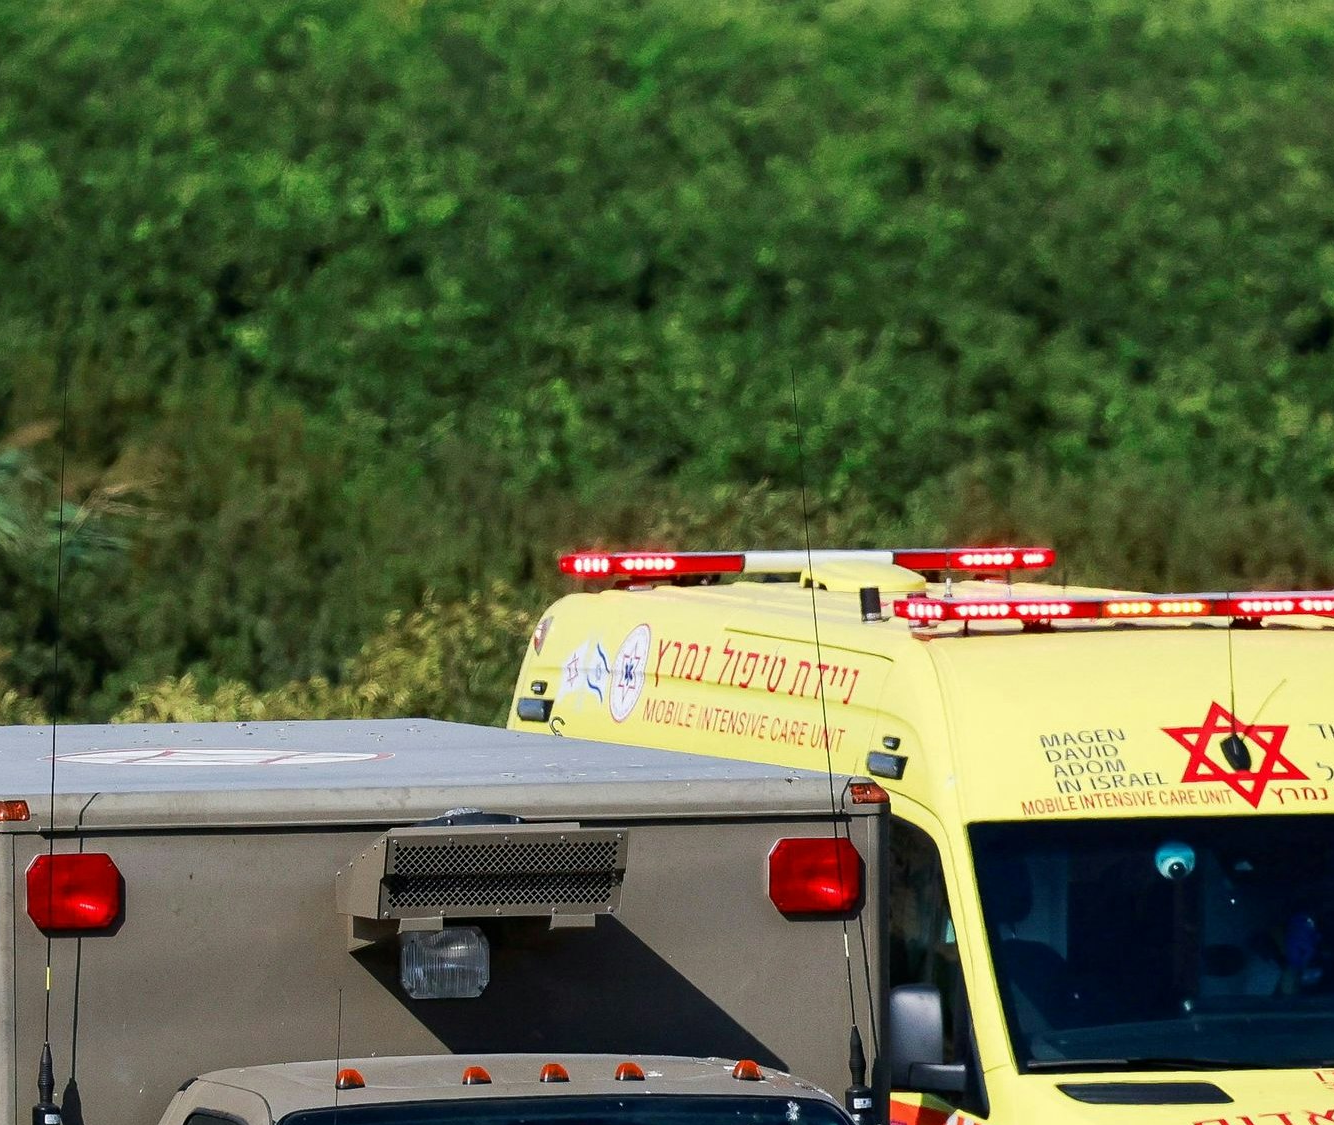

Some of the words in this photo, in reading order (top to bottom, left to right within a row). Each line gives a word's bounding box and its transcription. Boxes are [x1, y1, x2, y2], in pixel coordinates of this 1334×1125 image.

[655, 639, 712, 687] נמרץ
[718, 638, 787, 693] טיפול
[789, 660, 860, 705] ניידת
[642, 698, 696, 728] MOBILE
[697, 706, 769, 740] INTENSIVE
[770, 717, 808, 746] CARE
[810, 725, 846, 753] UNIT
[1039, 728, 1126, 748] MAGEN
[1045, 744, 1119, 763] DAVID
[1054, 758, 1126, 778] ADOM
[1055, 779, 1082, 794] IN
[1090, 772, 1169, 790] ISRAEL
[1021, 795, 1078, 816] MOBILE
[1079, 789, 1155, 810] INTENSIVE
[1158, 789, 1198, 805] CARE
[1199, 789, 1234, 805] UNIT
[1270, 786, 1329, 805] נמרץ
